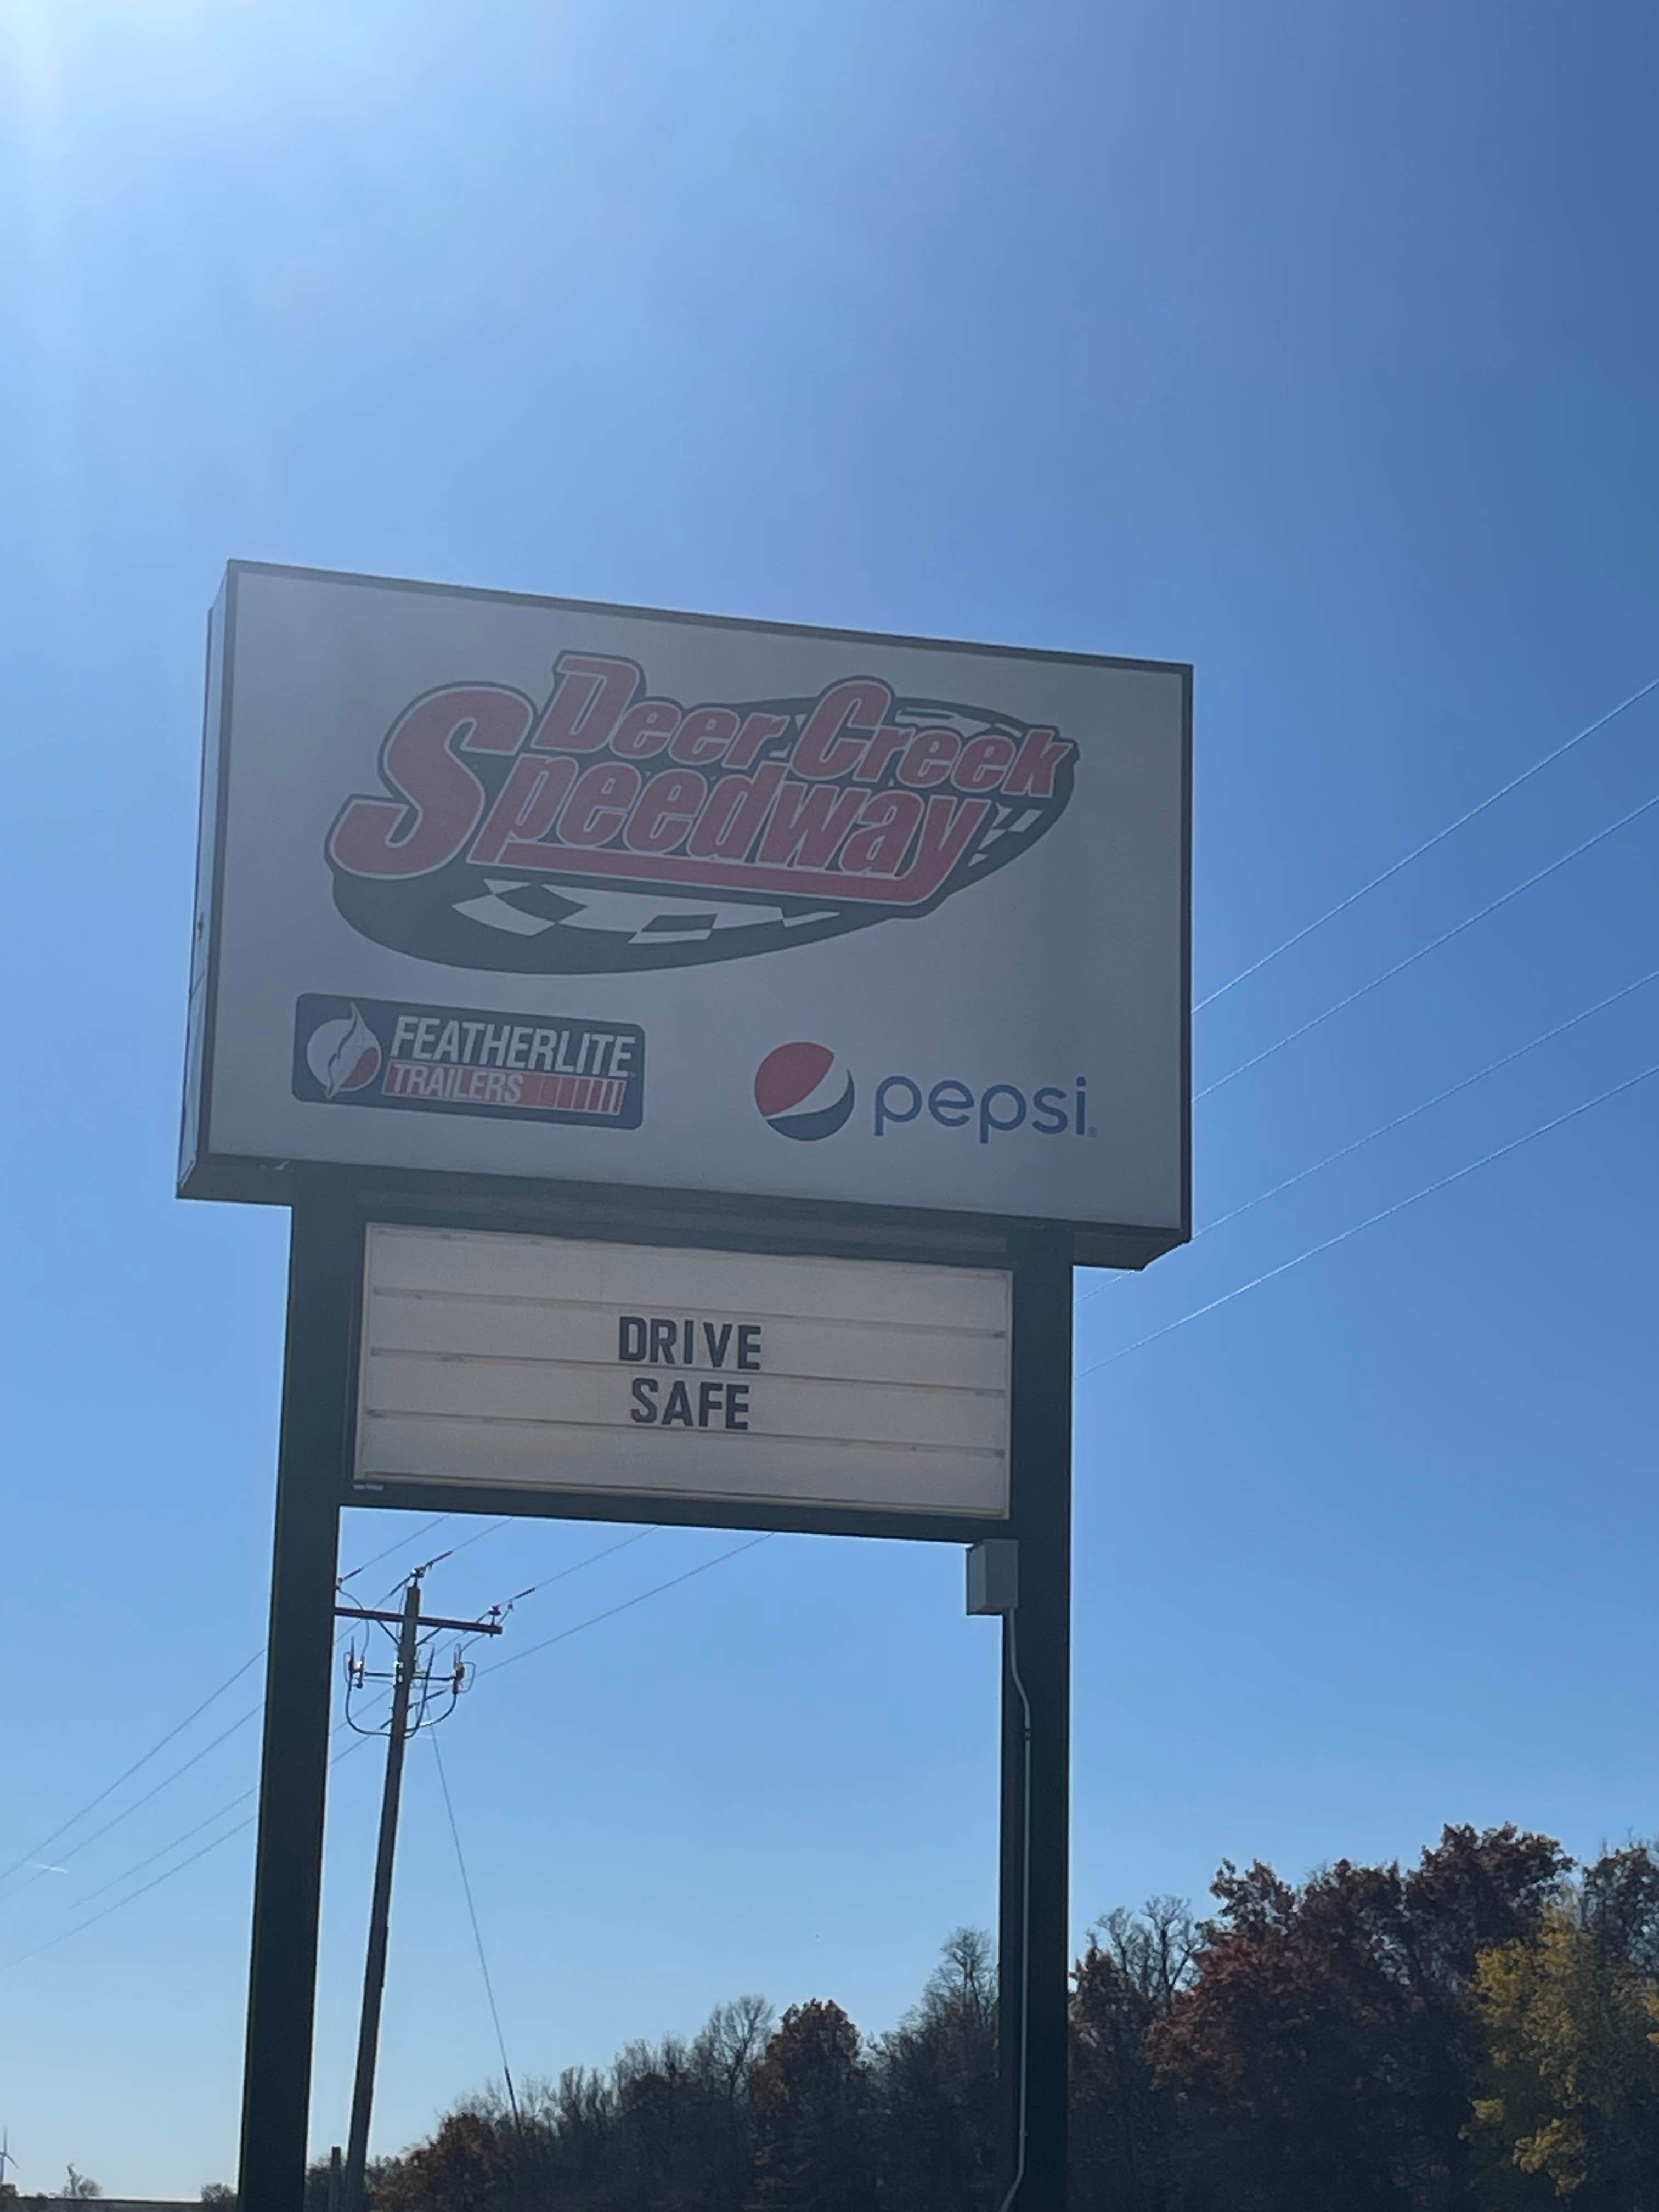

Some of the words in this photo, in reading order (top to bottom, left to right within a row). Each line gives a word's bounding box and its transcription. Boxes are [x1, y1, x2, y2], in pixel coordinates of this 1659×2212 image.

[531, 656, 788, 768] Deer
[791, 680, 1074, 798] Creek
[329, 686, 991, 905] Speedway
[390, 1015, 635, 1077] FEATHERLITE
[392, 1063, 523, 1103] TRAILERS
[874, 1076, 1087, 1144] pepsi
[619, 1316, 761, 1370] DRIVE
[631, 1378, 749, 1430] SAFE
